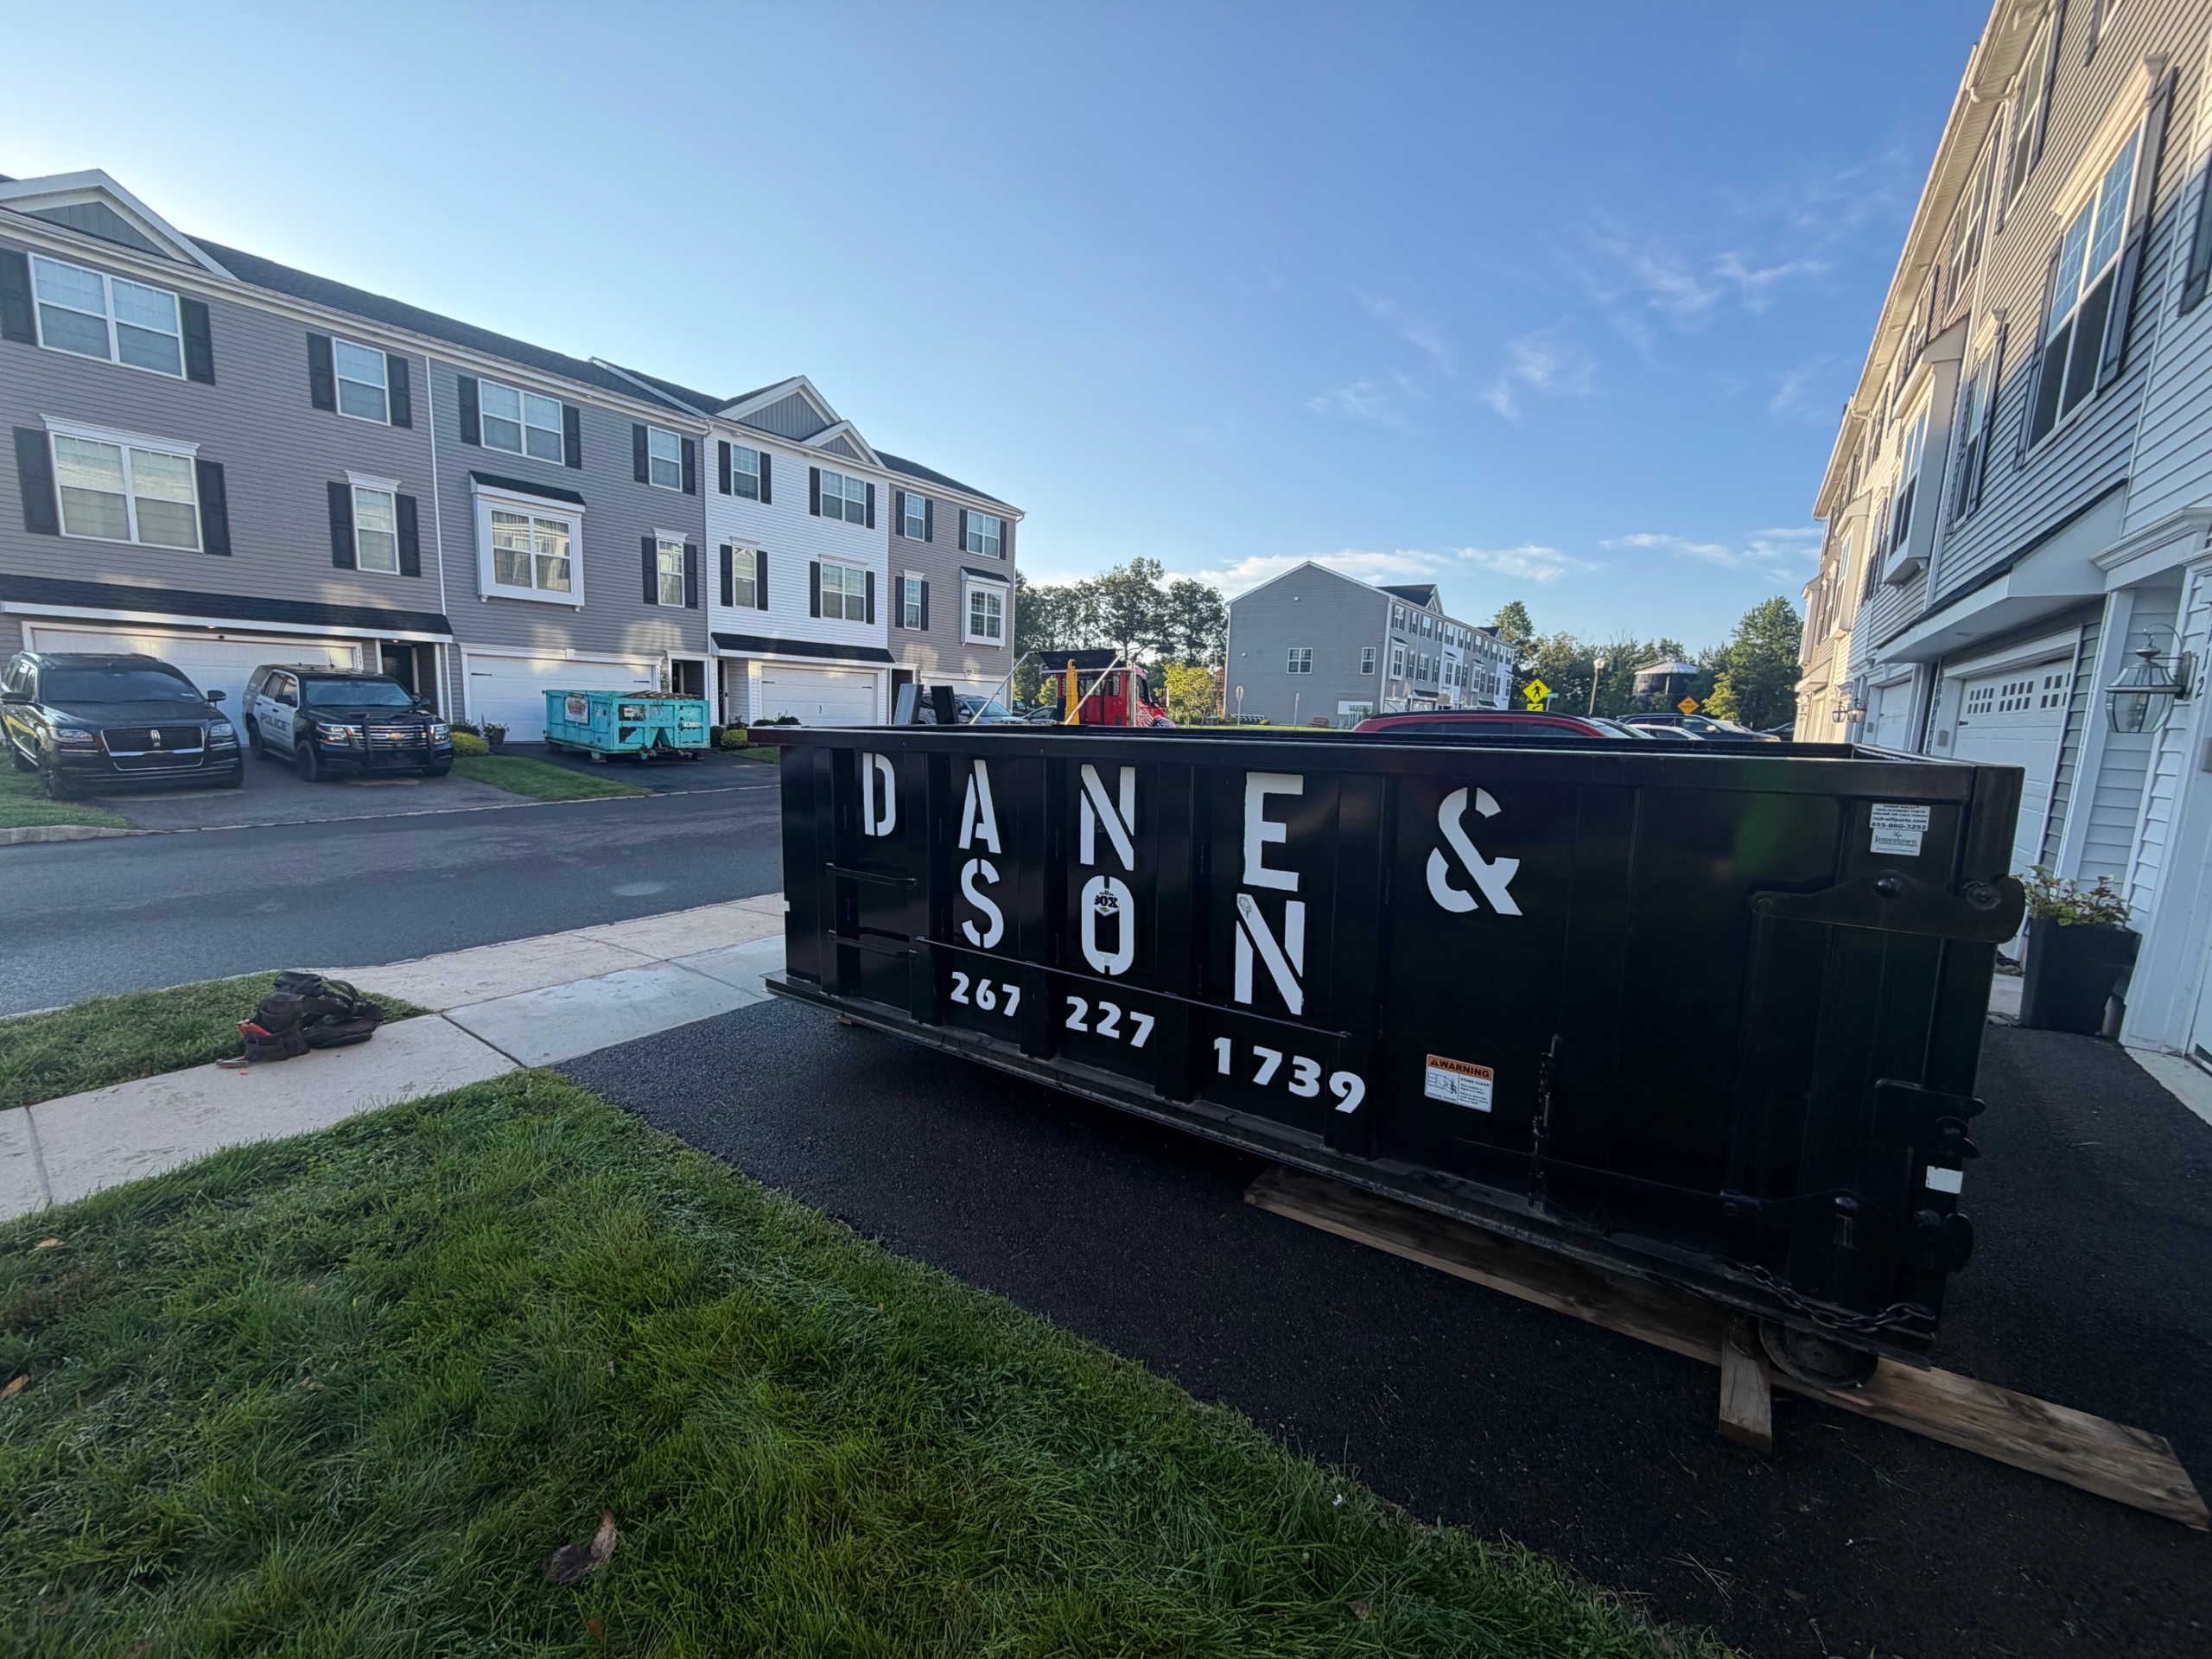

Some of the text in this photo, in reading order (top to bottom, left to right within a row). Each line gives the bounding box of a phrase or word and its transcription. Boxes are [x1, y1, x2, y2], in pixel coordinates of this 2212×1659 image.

[260, 713, 288, 731] POLICE
[862, 752, 1524, 917] DANE &
[1875, 836, 1916, 844] Jamestown
[960, 858, 1306, 1015] SON
[950, 971, 1366, 1114] 267 227 1739
[1440, 1059, 1490, 1077] WARNING
